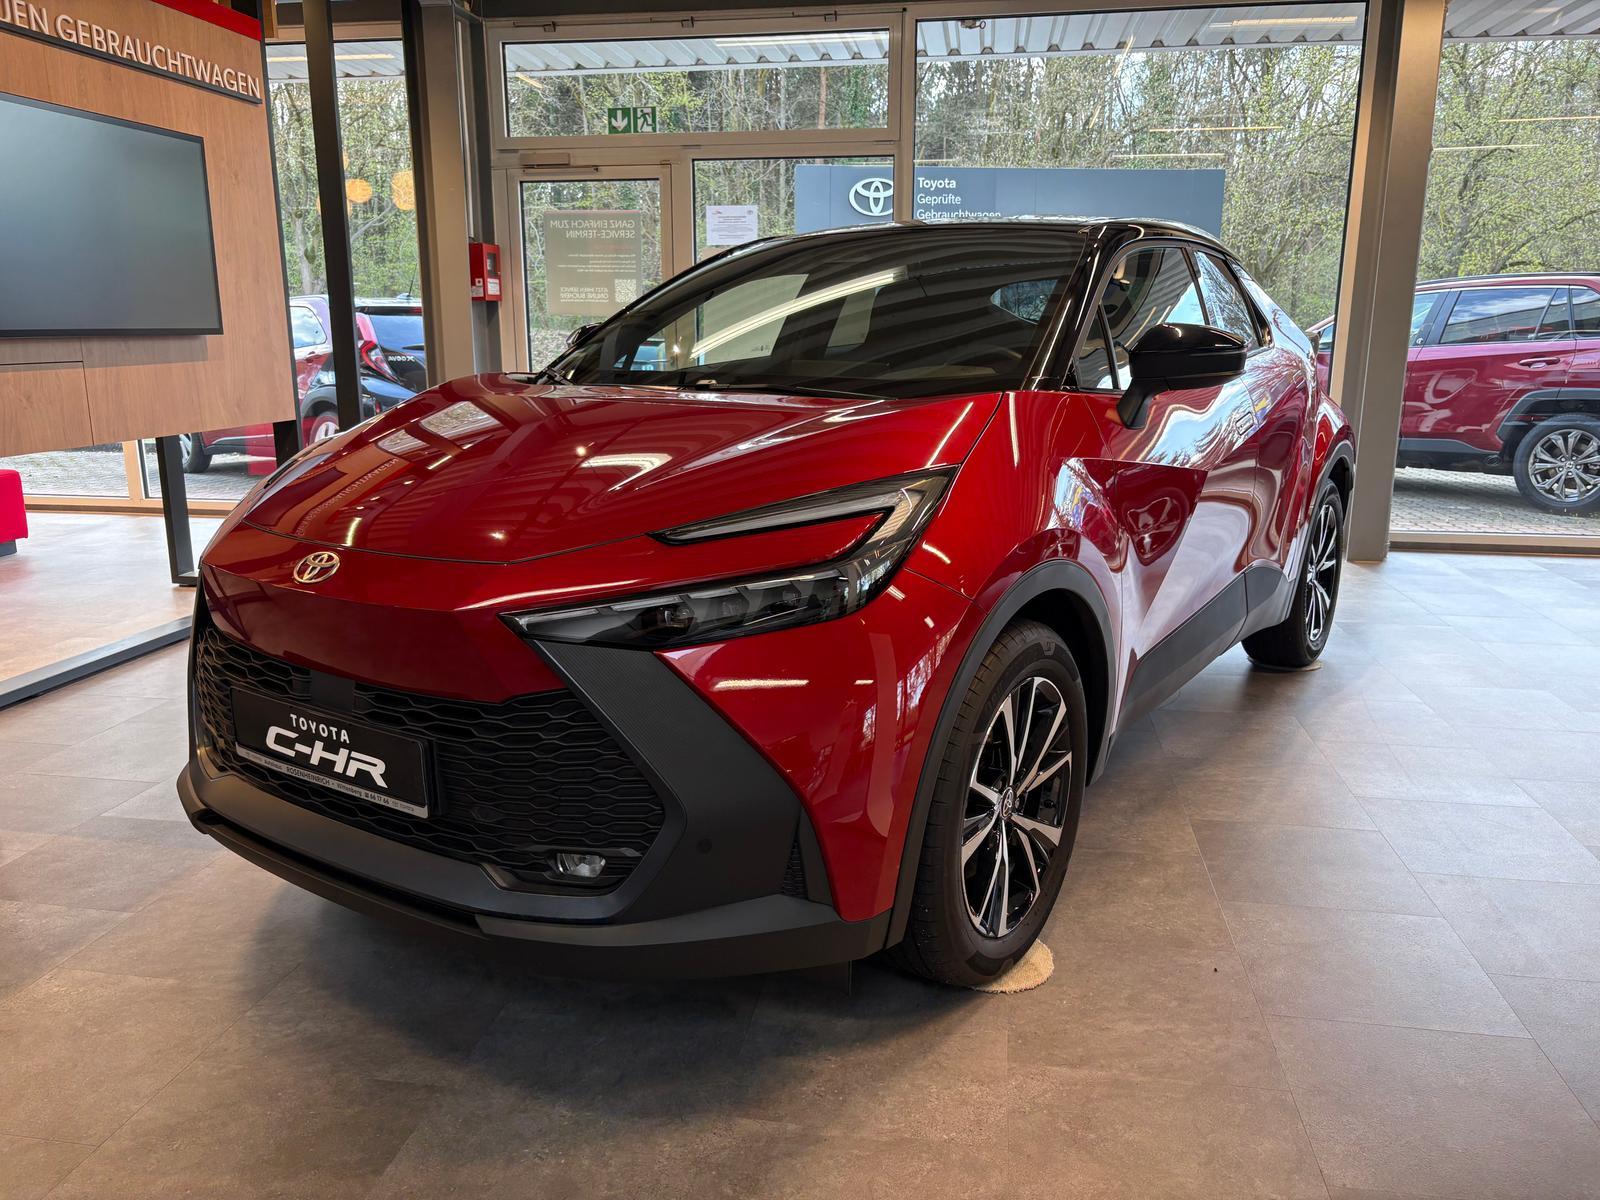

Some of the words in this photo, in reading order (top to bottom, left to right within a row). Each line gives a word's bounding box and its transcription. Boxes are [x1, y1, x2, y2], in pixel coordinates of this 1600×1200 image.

[54, 14, 261, 99] GEBRAUCHTWAGEN
[917, 177, 957, 191] Toyota
[917, 193, 962, 206] Geprüfte
[289, 713, 350, 744] TOYOTA
[265, 725, 389, 789] C-HR
